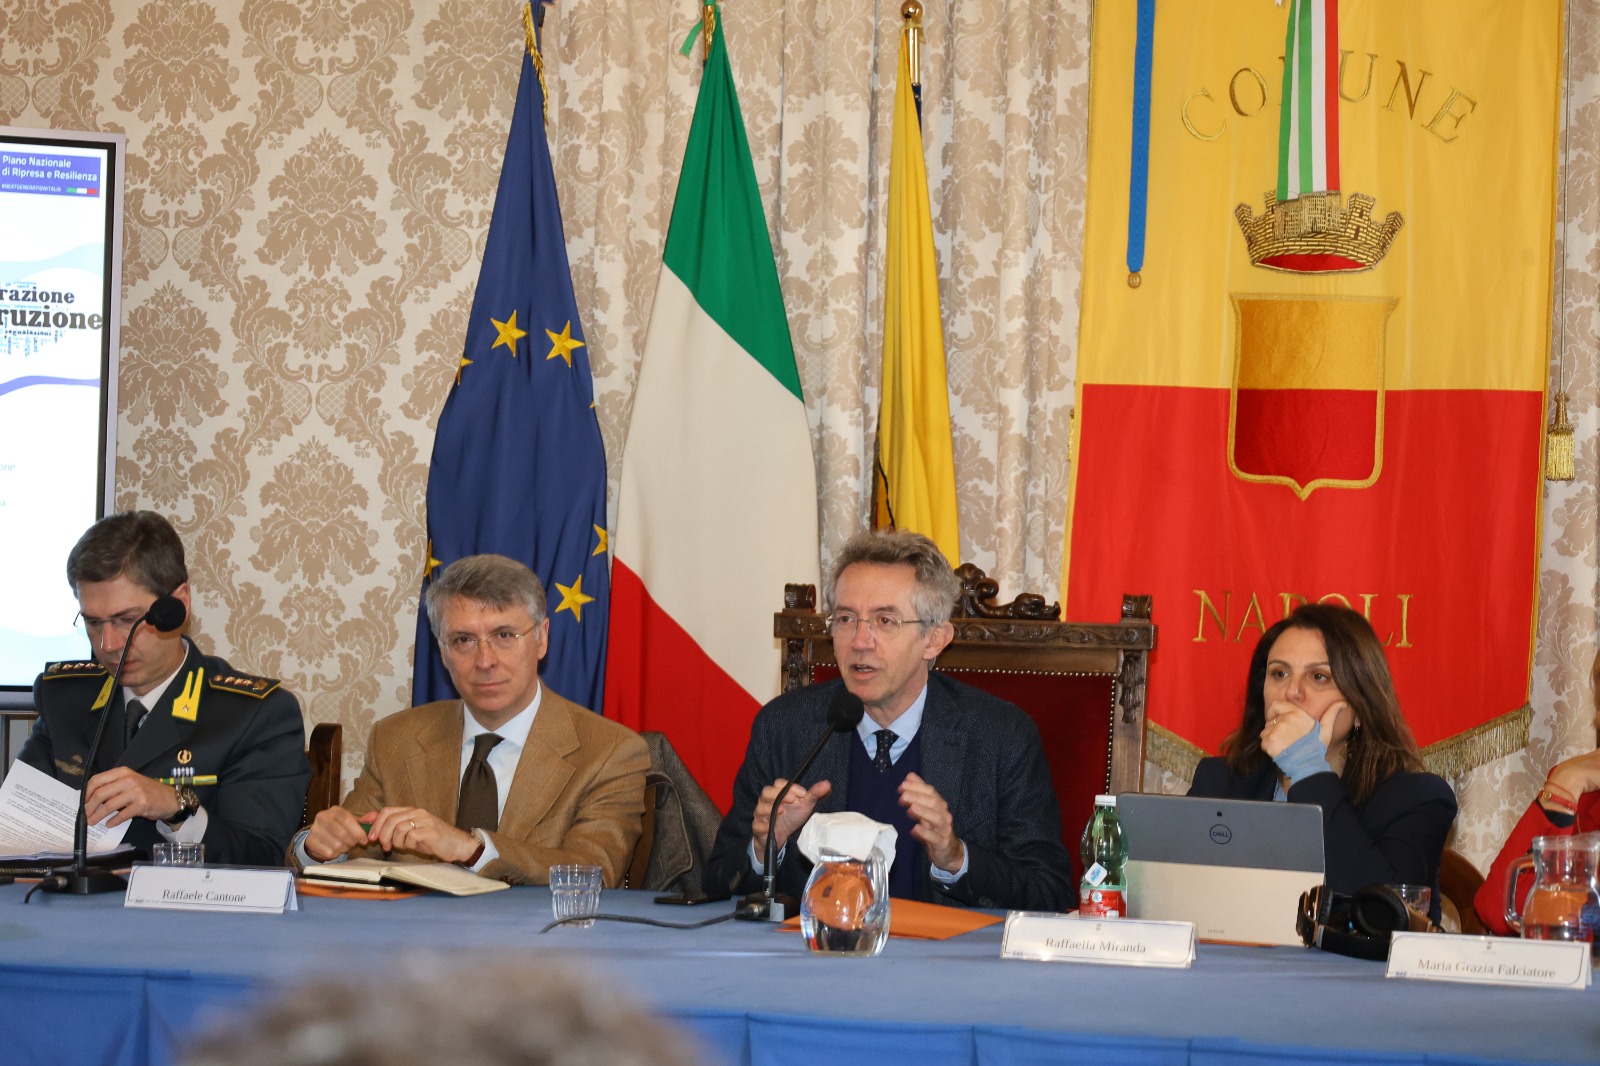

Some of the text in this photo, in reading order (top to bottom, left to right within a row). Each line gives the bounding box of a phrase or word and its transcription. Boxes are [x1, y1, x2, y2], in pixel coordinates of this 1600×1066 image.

[1181, 49, 1478, 143] COUNE
[2, 155, 72, 168] Piano Nazionale
[2, 167, 98, 182] di Ripresa e Resilienza
[1192, 590, 1414, 648] NALI
[162, 889, 246, 902] Raffaele Cantone
[1045, 937, 1146, 953] Raffaella Miranda
[1418, 959, 1556, 978] Maria Grazia Falciatore
